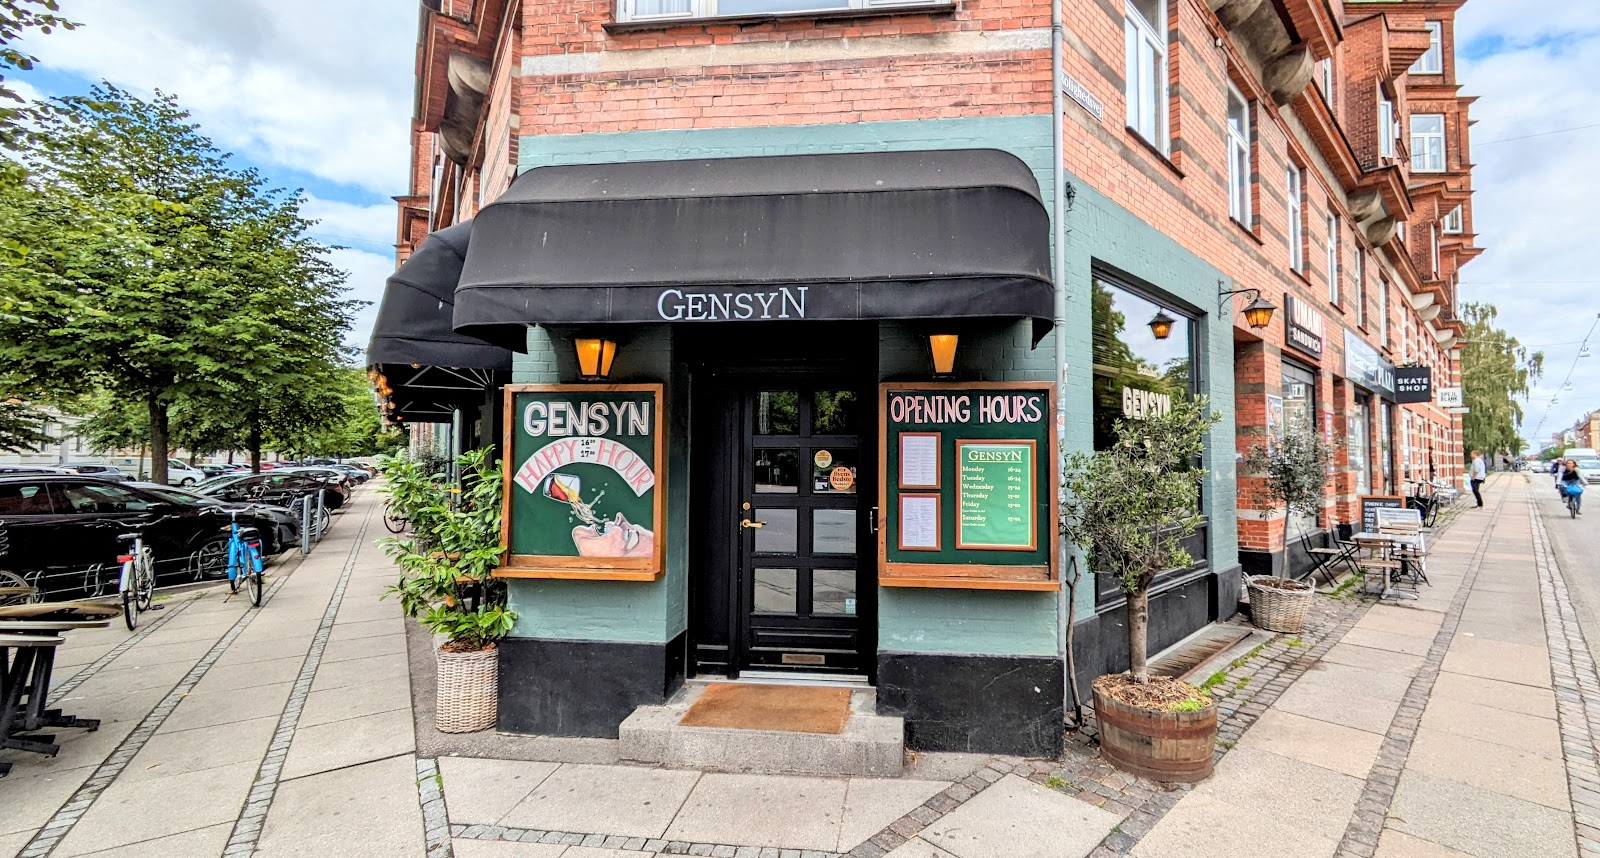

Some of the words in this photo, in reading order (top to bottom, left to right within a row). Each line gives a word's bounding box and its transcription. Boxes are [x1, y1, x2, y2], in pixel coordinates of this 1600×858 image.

[657, 286, 809, 320] GENSYN
[1397, 377, 1428, 385] SKATE
[523, 401, 650, 436] GENSYN
[890, 396, 970, 424] OPENING
[979, 396, 1042, 424] HOURS
[517, 440, 579, 490] HAPPY
[595, 440, 654, 494] HOUR
[968, 450, 1022, 461] GENSYN
